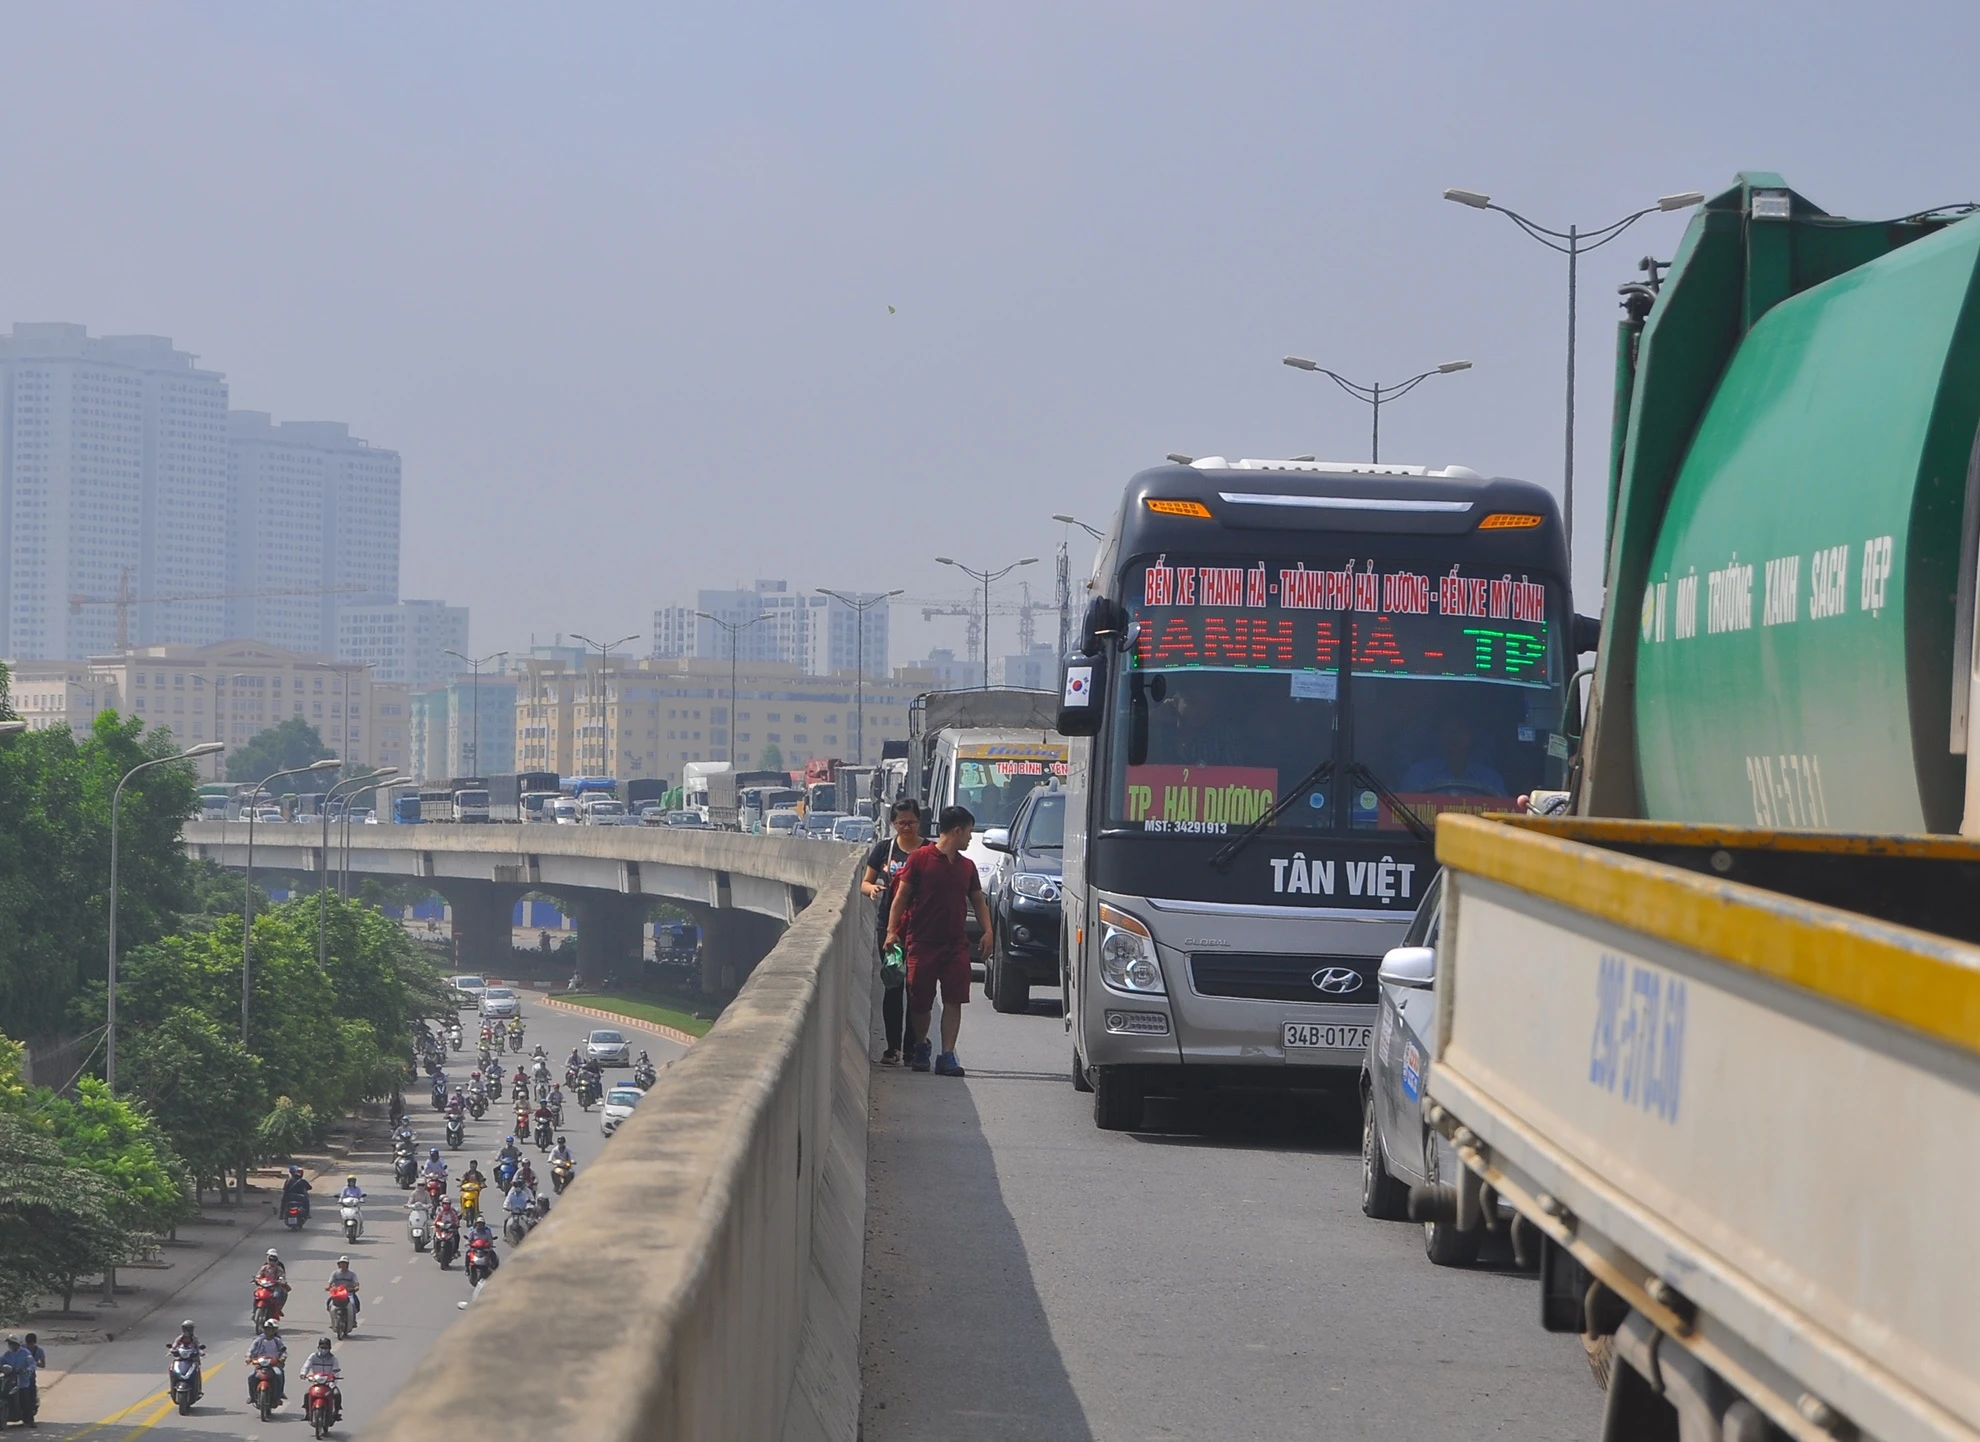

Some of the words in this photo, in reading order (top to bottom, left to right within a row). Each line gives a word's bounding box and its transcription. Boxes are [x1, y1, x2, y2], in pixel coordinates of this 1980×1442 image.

[1144, 554, 1173, 607] BẾN
[1176, 567, 1196, 606] XE
[1199, 567, 1244, 607] THANH
[1247, 561, 1267, 608] HÀ
[1280, 561, 1325, 610] THÀNH
[1325, 559, 1354, 611] PHỐ
[1354, 559, 1379, 612] HẢI
[1383, 570, 1429, 615] DƯƠNG
[1439, 564, 1468, 617] BẾN
[1468, 578, 1487, 618] XE
[1489, 574, 1512, 620] MỸ
[1512, 575, 1545, 624] ĐÌNH
[1675, 565, 1699, 640] MÔI
[1763, 555, 1800, 627] XANH
[1860, 535, 1893, 619] ĐẸP
[996, 760, 1018, 775] THÁI
[1018, 760, 1042, 775] BÌNH
[1163, 768, 1198, 823] HẢI
[1203, 784, 1276, 826] DƯƠNG
[1144, 820, 1172, 832] MST:
[1173, 821, 1228, 834] 34291913
[1269, 851, 1335, 895] TÂN
[1345, 855, 1416, 904] VIỆT
[1184, 937, 1231, 947] GLOBAL
